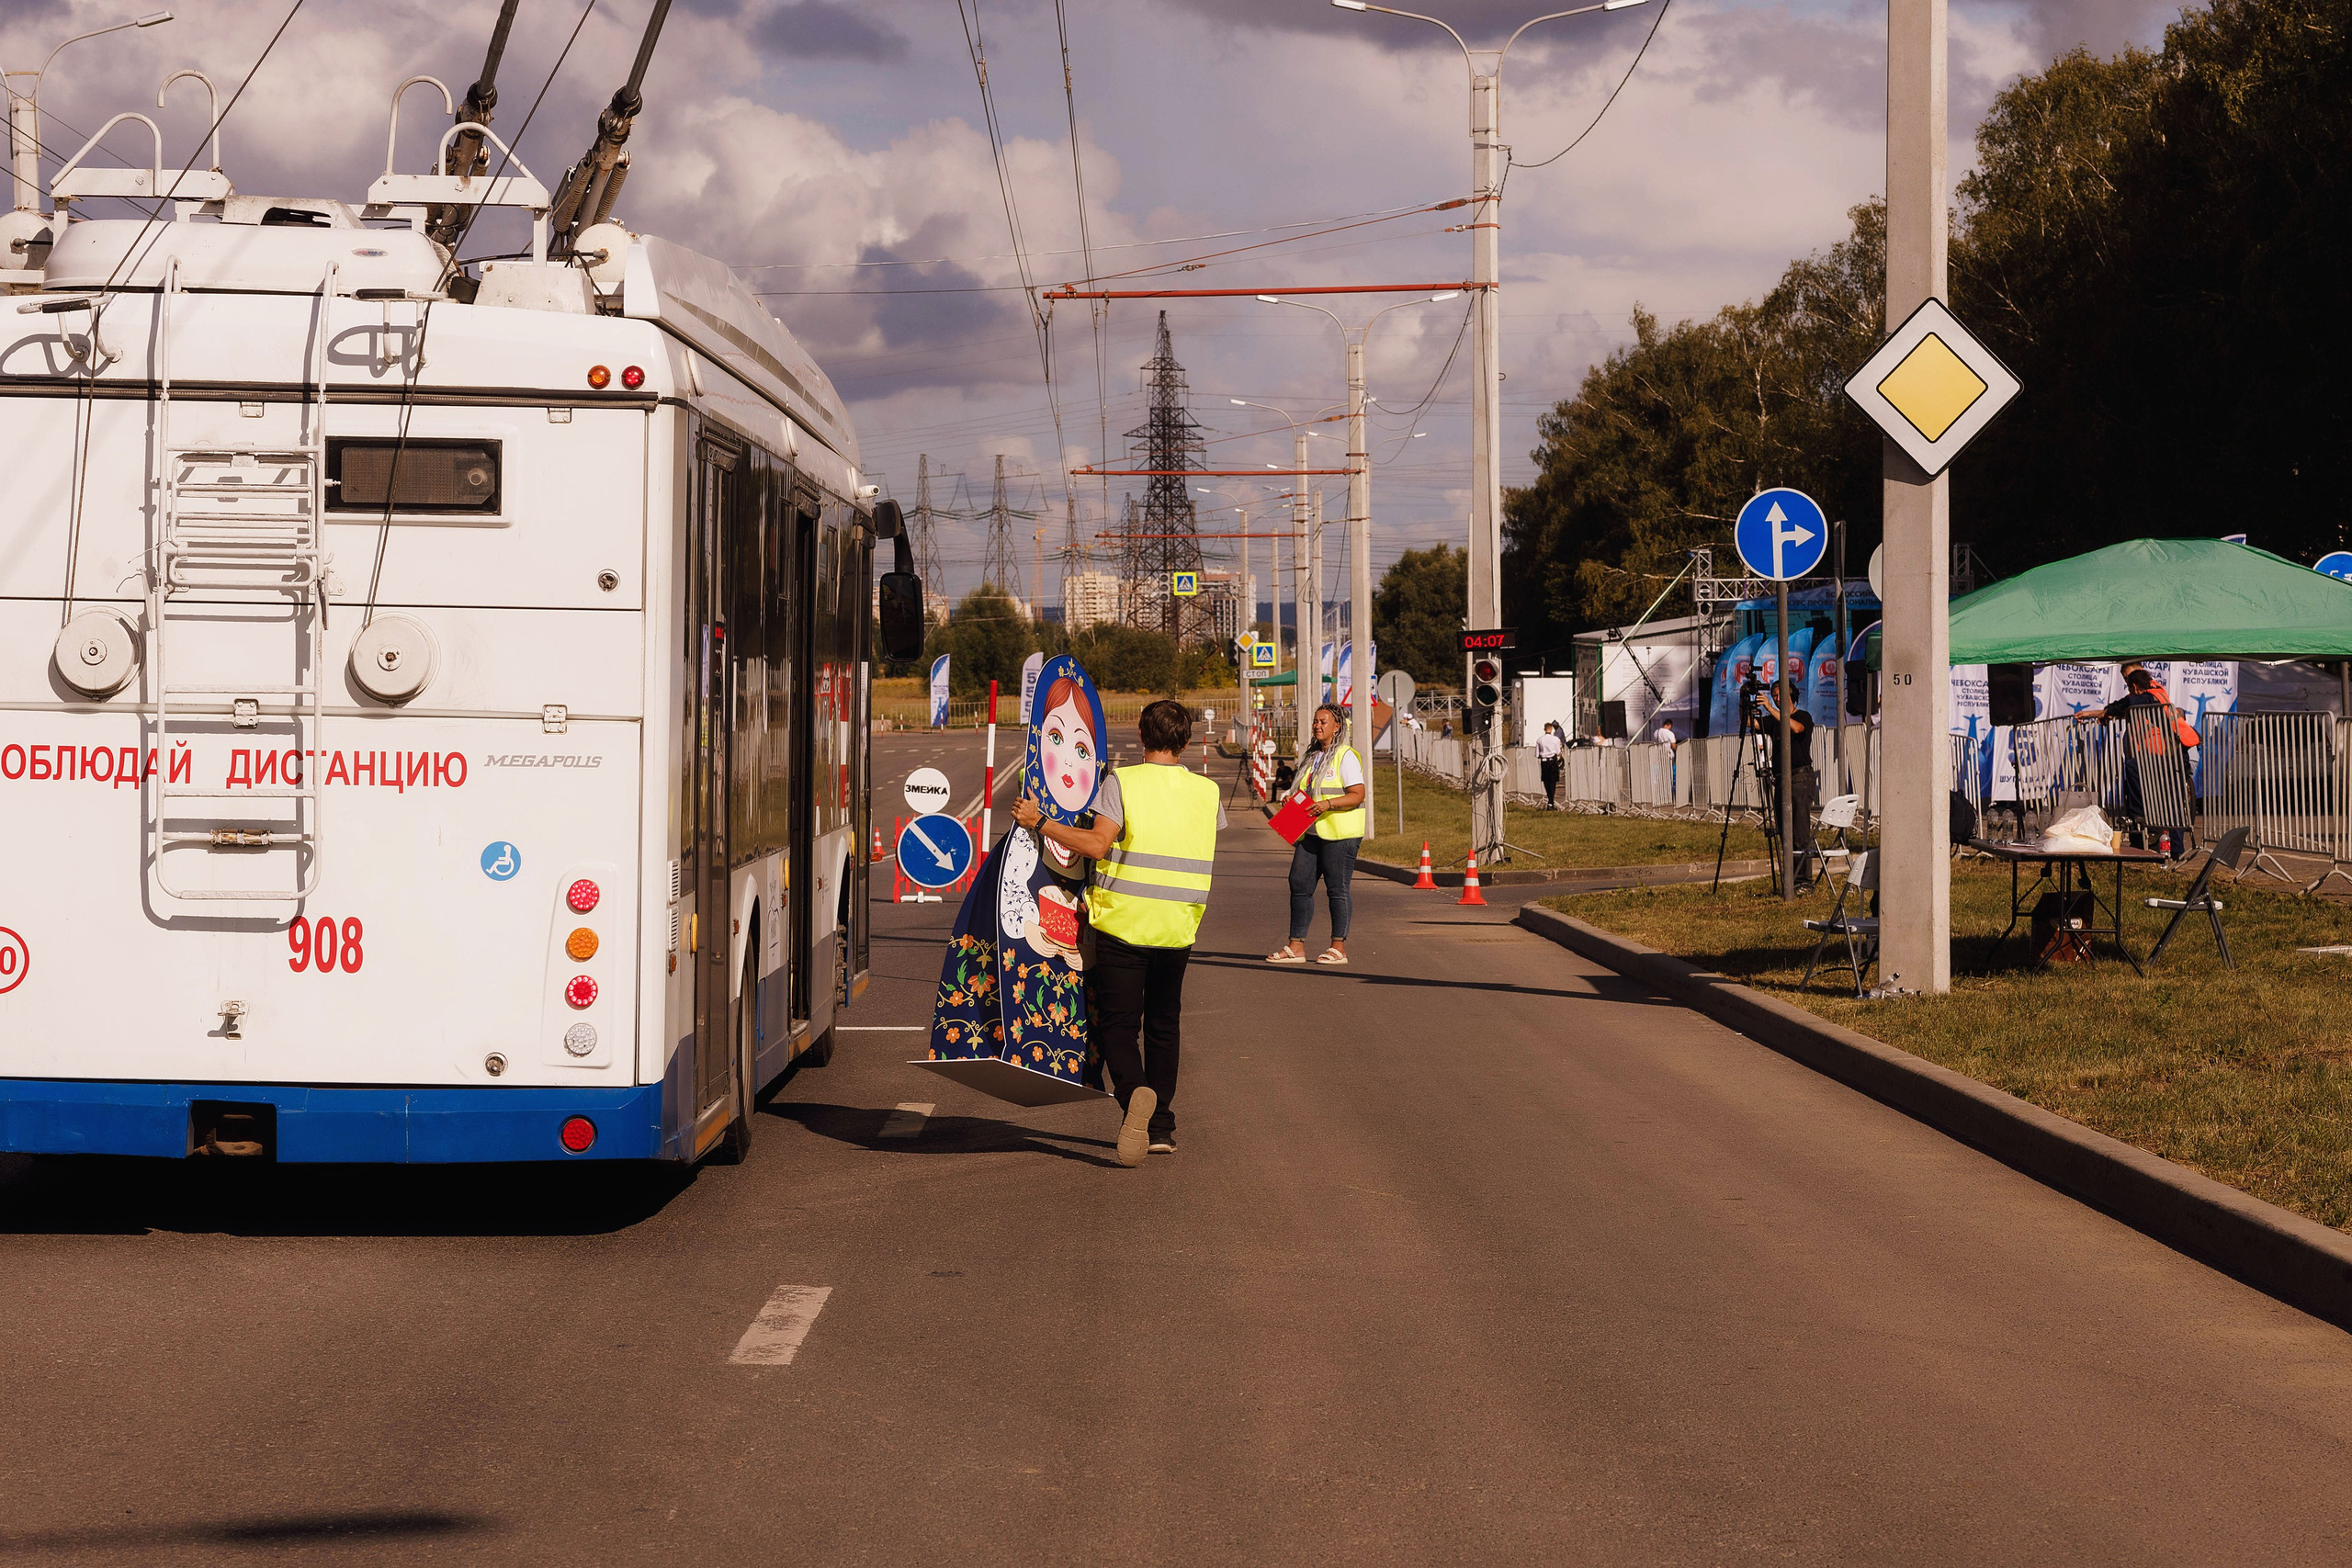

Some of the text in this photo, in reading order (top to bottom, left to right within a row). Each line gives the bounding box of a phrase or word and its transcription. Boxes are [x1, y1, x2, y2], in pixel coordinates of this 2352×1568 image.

[1464, 635, 1505, 649] 04:07
[2067, 672, 2098, 681] СТОЛИЦА
[2182, 668, 2229, 677] ЧУВАШСКОЙ
[1951, 679, 1989, 687] ЧЕБОКСА
[2062, 680, 2102, 688] ЧУВАШСКОЙ
[2182, 677, 2228, 685] РЕСПУБЛИКИ
[2062, 687, 2102, 695] РЕСПУБЛИКИ
[483, 754, 603, 769] MEGAPOLIS
[226, 749, 468, 795] ДИСТАНЦИЮ
[905, 784, 948, 795] ЗМЕЙКА
[288, 915, 364, 974] 908
